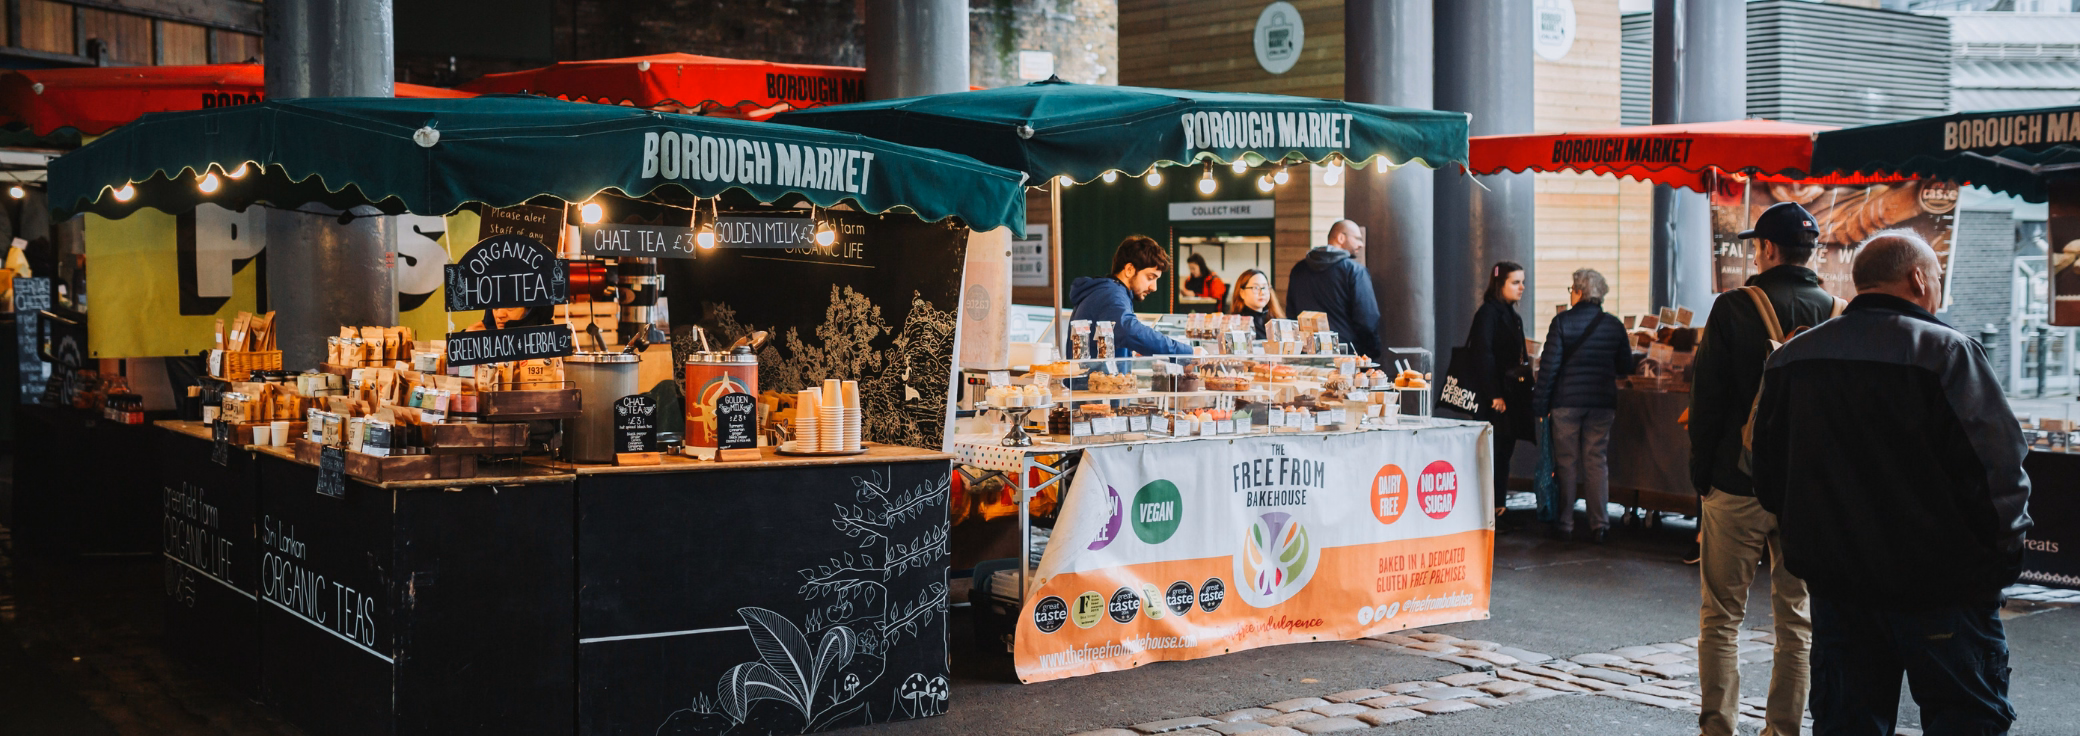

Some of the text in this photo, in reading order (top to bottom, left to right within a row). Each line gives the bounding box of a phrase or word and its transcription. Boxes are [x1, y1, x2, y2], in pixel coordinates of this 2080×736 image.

[766, 72, 838, 102] BOROUGH
[1182, 110, 1354, 150] BOROUGH MARKET
[1944, 114, 2042, 150] BOROUGH
[1552, 137, 1694, 164] BOROUGH MARKET
[642, 131, 875, 195] BOROUGH MARKET
[491, 207, 546, 223] Please alert
[1192, 204, 1251, 216] COLLECT HERE
[490, 224, 513, 235] Staff
[714, 222, 761, 244] GOLDEN
[765, 222, 801, 244] MILK
[800, 224, 815, 244] £3
[840, 218, 865, 235] farm
[594, 229, 694, 253] CHAI TEA £3
[843, 242, 864, 259] LIFE
[469, 241, 543, 275] ORGANIC
[465, 273, 548, 306] HOT TEA
[483, 334, 516, 359] BLACK
[524, 331, 560, 354] HERBAL
[527, 366, 544, 375] 1931
[623, 397, 645, 406] CHAI
[725, 396, 748, 404] GOLDEN
[1440, 392, 1479, 413] MUSEUM
[1443, 384, 1476, 402] DESIGN
[628, 406, 644, 415] TEA
[1272, 444, 1285, 455] THE
[1233, 457, 1325, 493] FREE FROM
[1378, 474, 1402, 496] DAIRY
[1421, 471, 1456, 493] NO CANE
[1247, 489, 1306, 507] BAKEHOUSE
[1380, 496, 1399, 517] FREE
[1425, 493, 1452, 514] SUGAR
[199, 488, 218, 530] farm
[1139, 500, 1174, 523] VEGAN
[264, 514, 306, 560] Sri Lankan
[2023, 537, 2059, 553] reats
[164, 515, 234, 584] ORGANIC LIFE
[1379, 547, 1466, 574] BAKED IN A DEDICATED
[1205, 584, 1219, 594] great
[1376, 565, 1466, 593] GLUTEN FREE PREMISES
[262, 551, 375, 647] ORGANIC TEAS
[1117, 592, 1134, 603] great
[1166, 594, 1193, 606] taste
[1172, 588, 1187, 597] great
[1200, 590, 1224, 603] taste
[1035, 610, 1067, 622] taste
[1042, 603, 1059, 613] great
[1110, 599, 1140, 612] taste
[1256, 615, 1324, 634] indulgence
